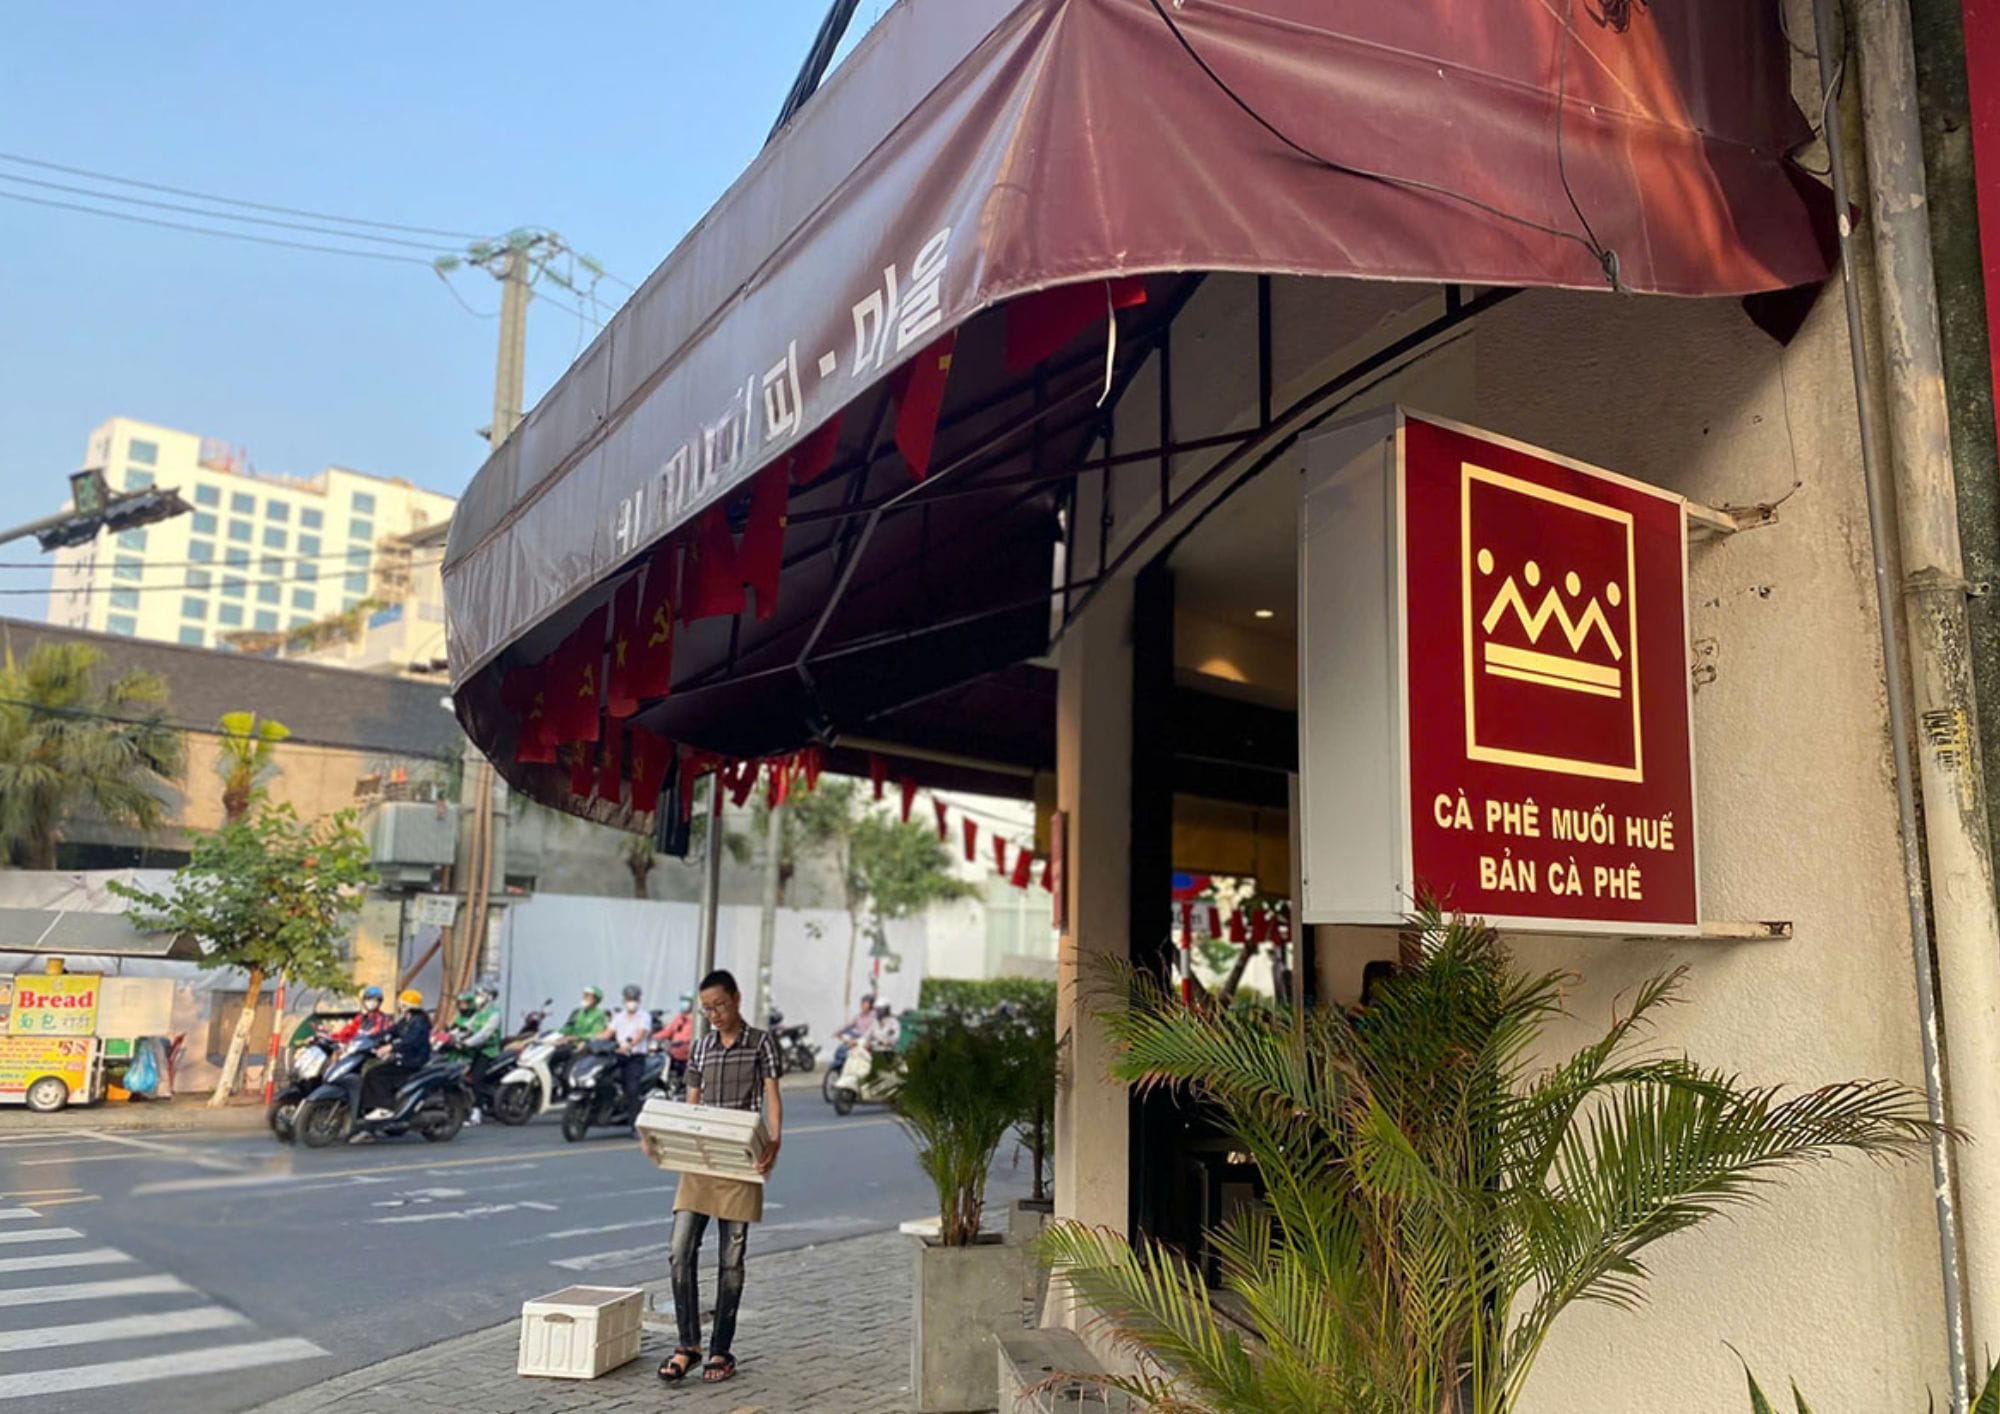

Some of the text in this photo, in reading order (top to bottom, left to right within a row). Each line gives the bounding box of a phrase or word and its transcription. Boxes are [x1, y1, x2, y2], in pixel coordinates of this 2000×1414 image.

[1433, 787, 1675, 851] CÀ PHÊ MUỐI HUẾ
[1479, 847, 1643, 901] BẢN CÀ PHÊ
[18, 990, 94, 1009] Bread
